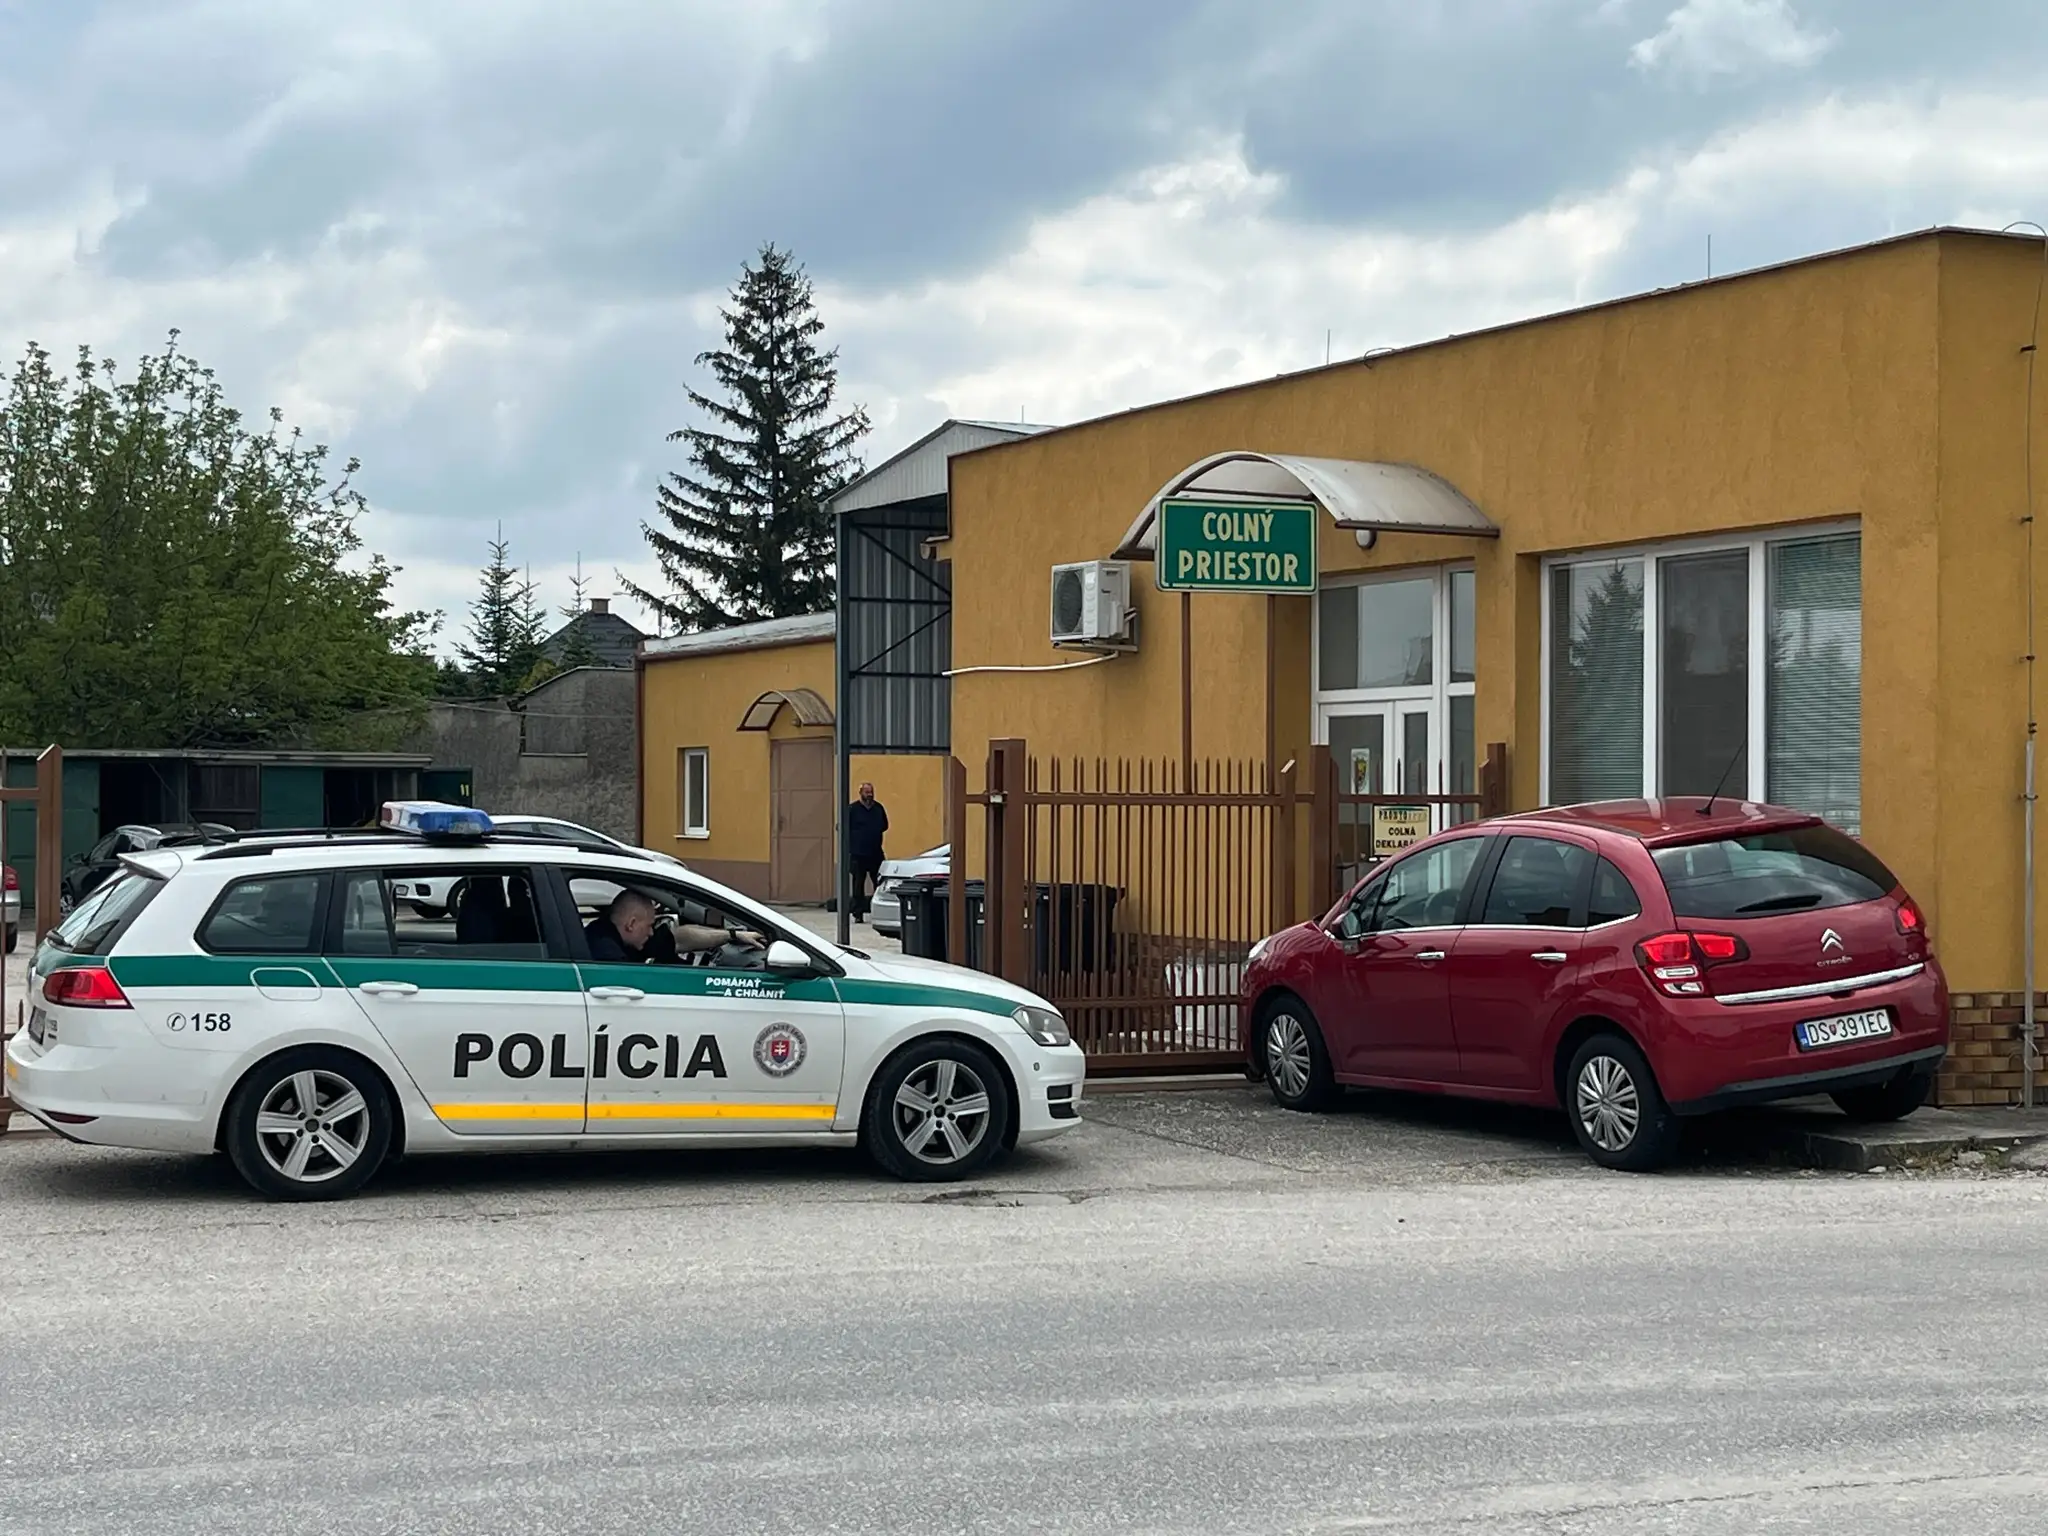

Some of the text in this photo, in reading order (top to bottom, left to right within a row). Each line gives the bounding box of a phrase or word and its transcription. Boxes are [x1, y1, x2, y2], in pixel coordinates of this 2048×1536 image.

[1203, 509, 1274, 543] COLNÝ
[1178, 550, 1298, 582] PRIESTOR
[1388, 826, 1415, 836] COLNÁ
[1375, 839, 1414, 848] DEKLARÁ
[706, 977, 761, 988] POMÁHAŤ
[724, 988, 786, 999] A CHRÁNIŤ
[190, 1012, 232, 1032] 158
[453, 1024, 728, 1079] POLÍCIA
